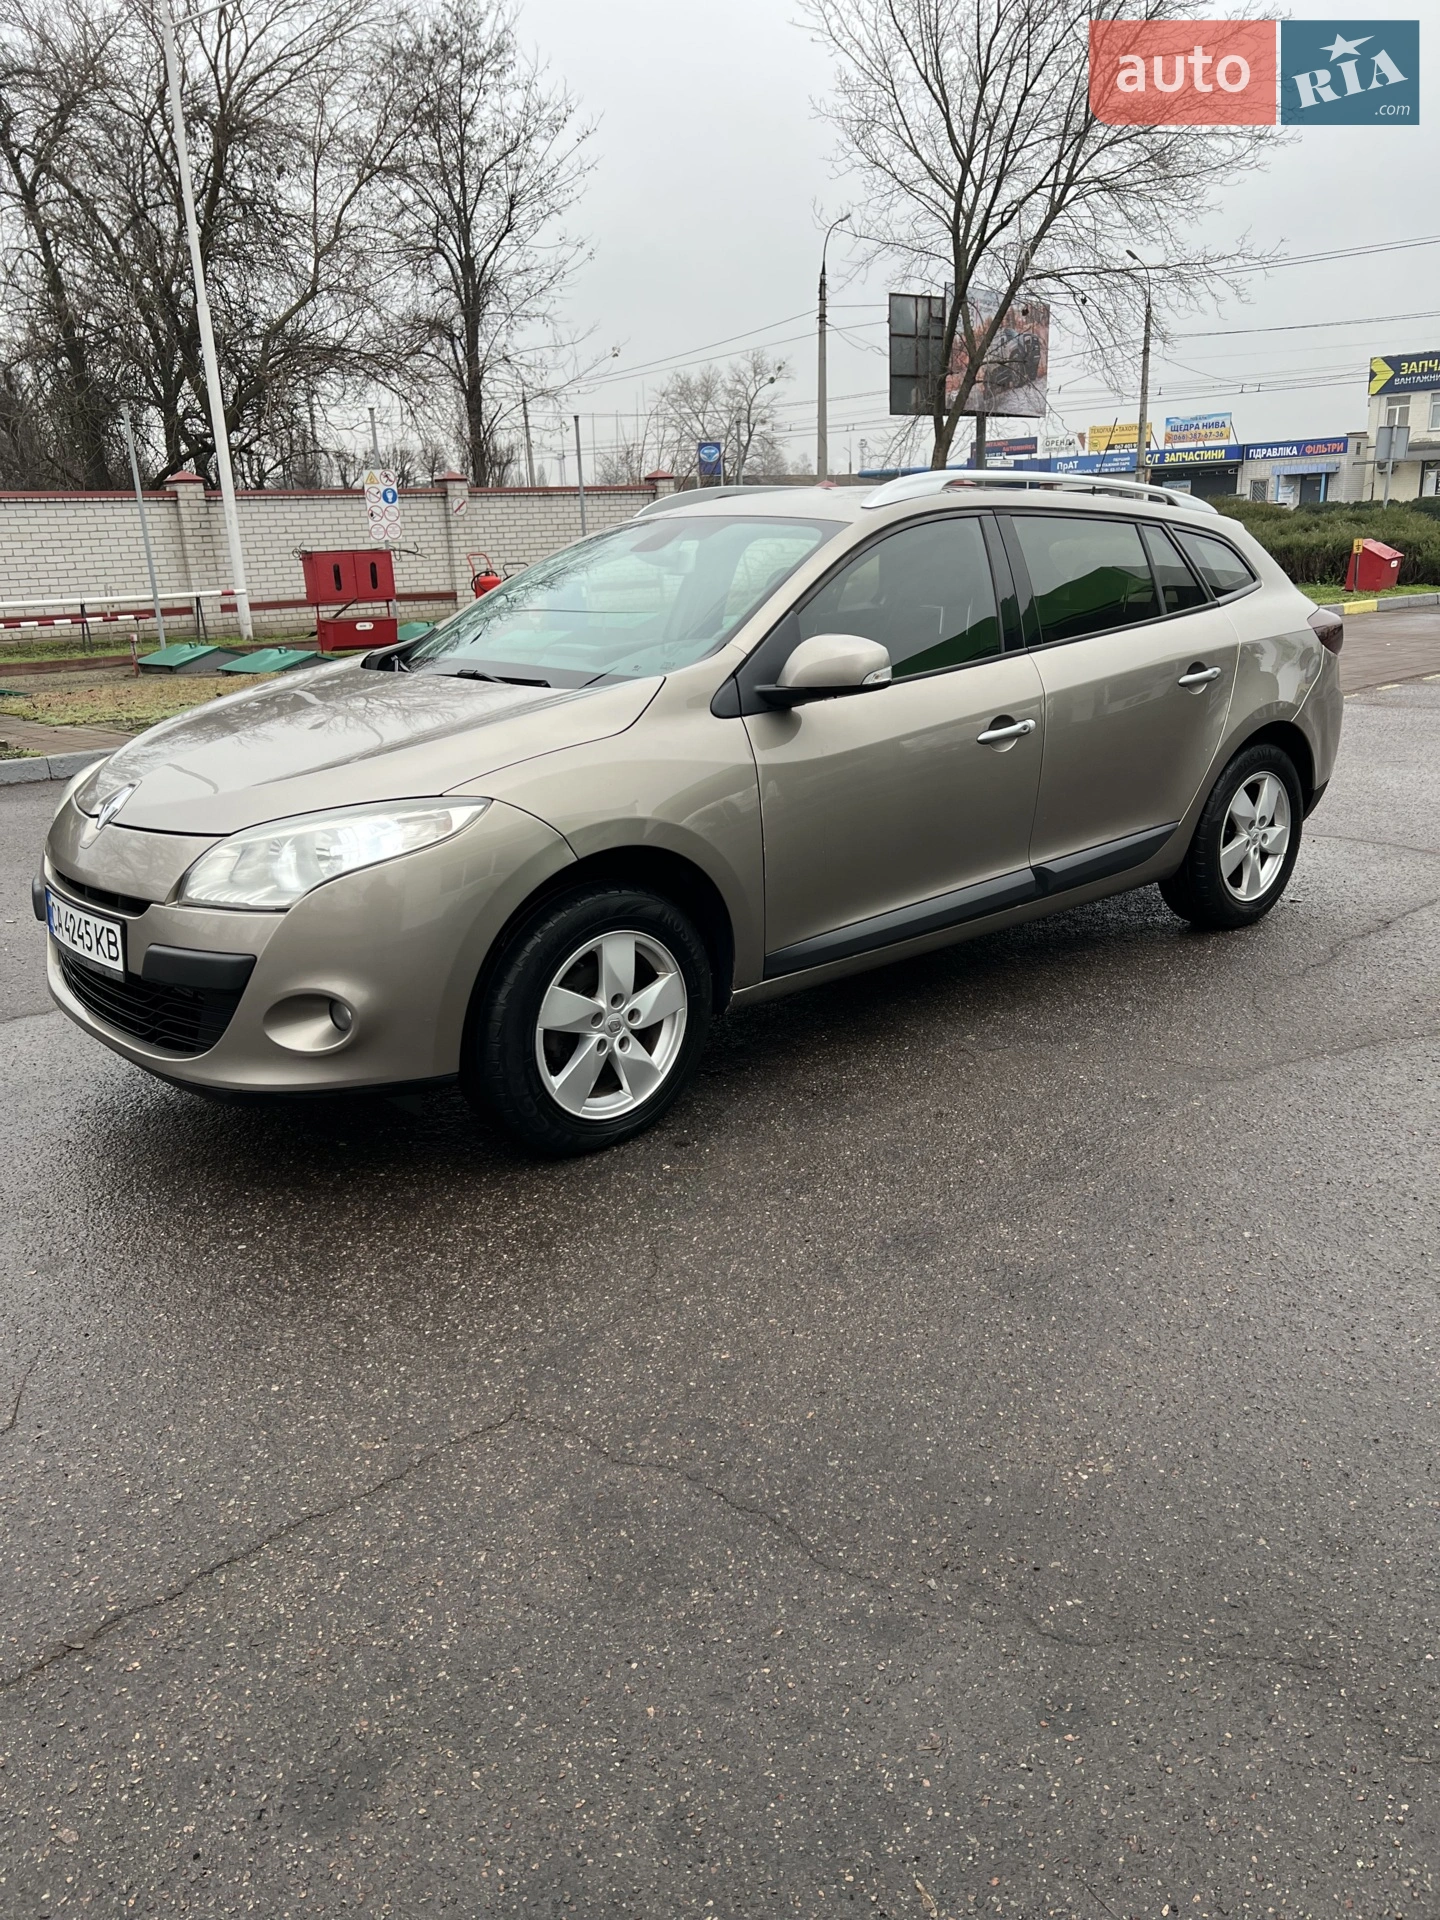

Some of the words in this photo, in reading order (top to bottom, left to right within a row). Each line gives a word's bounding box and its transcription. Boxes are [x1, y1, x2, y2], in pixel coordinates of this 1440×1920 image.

[1170, 423, 1200, 432] ЩЕДРА
[1202, 421, 1226, 430] НИВА
[1045, 438, 1076, 447] ОРЕНДА
[1164, 449, 1226, 463] ЗАПЧАСТИНИ
[1249, 446, 1298, 459] ГІДРАВЛІКА
[1305, 442, 1344, 455] ФІЛЬТРИ
[1057, 460, 1079, 472] ПрАТ
